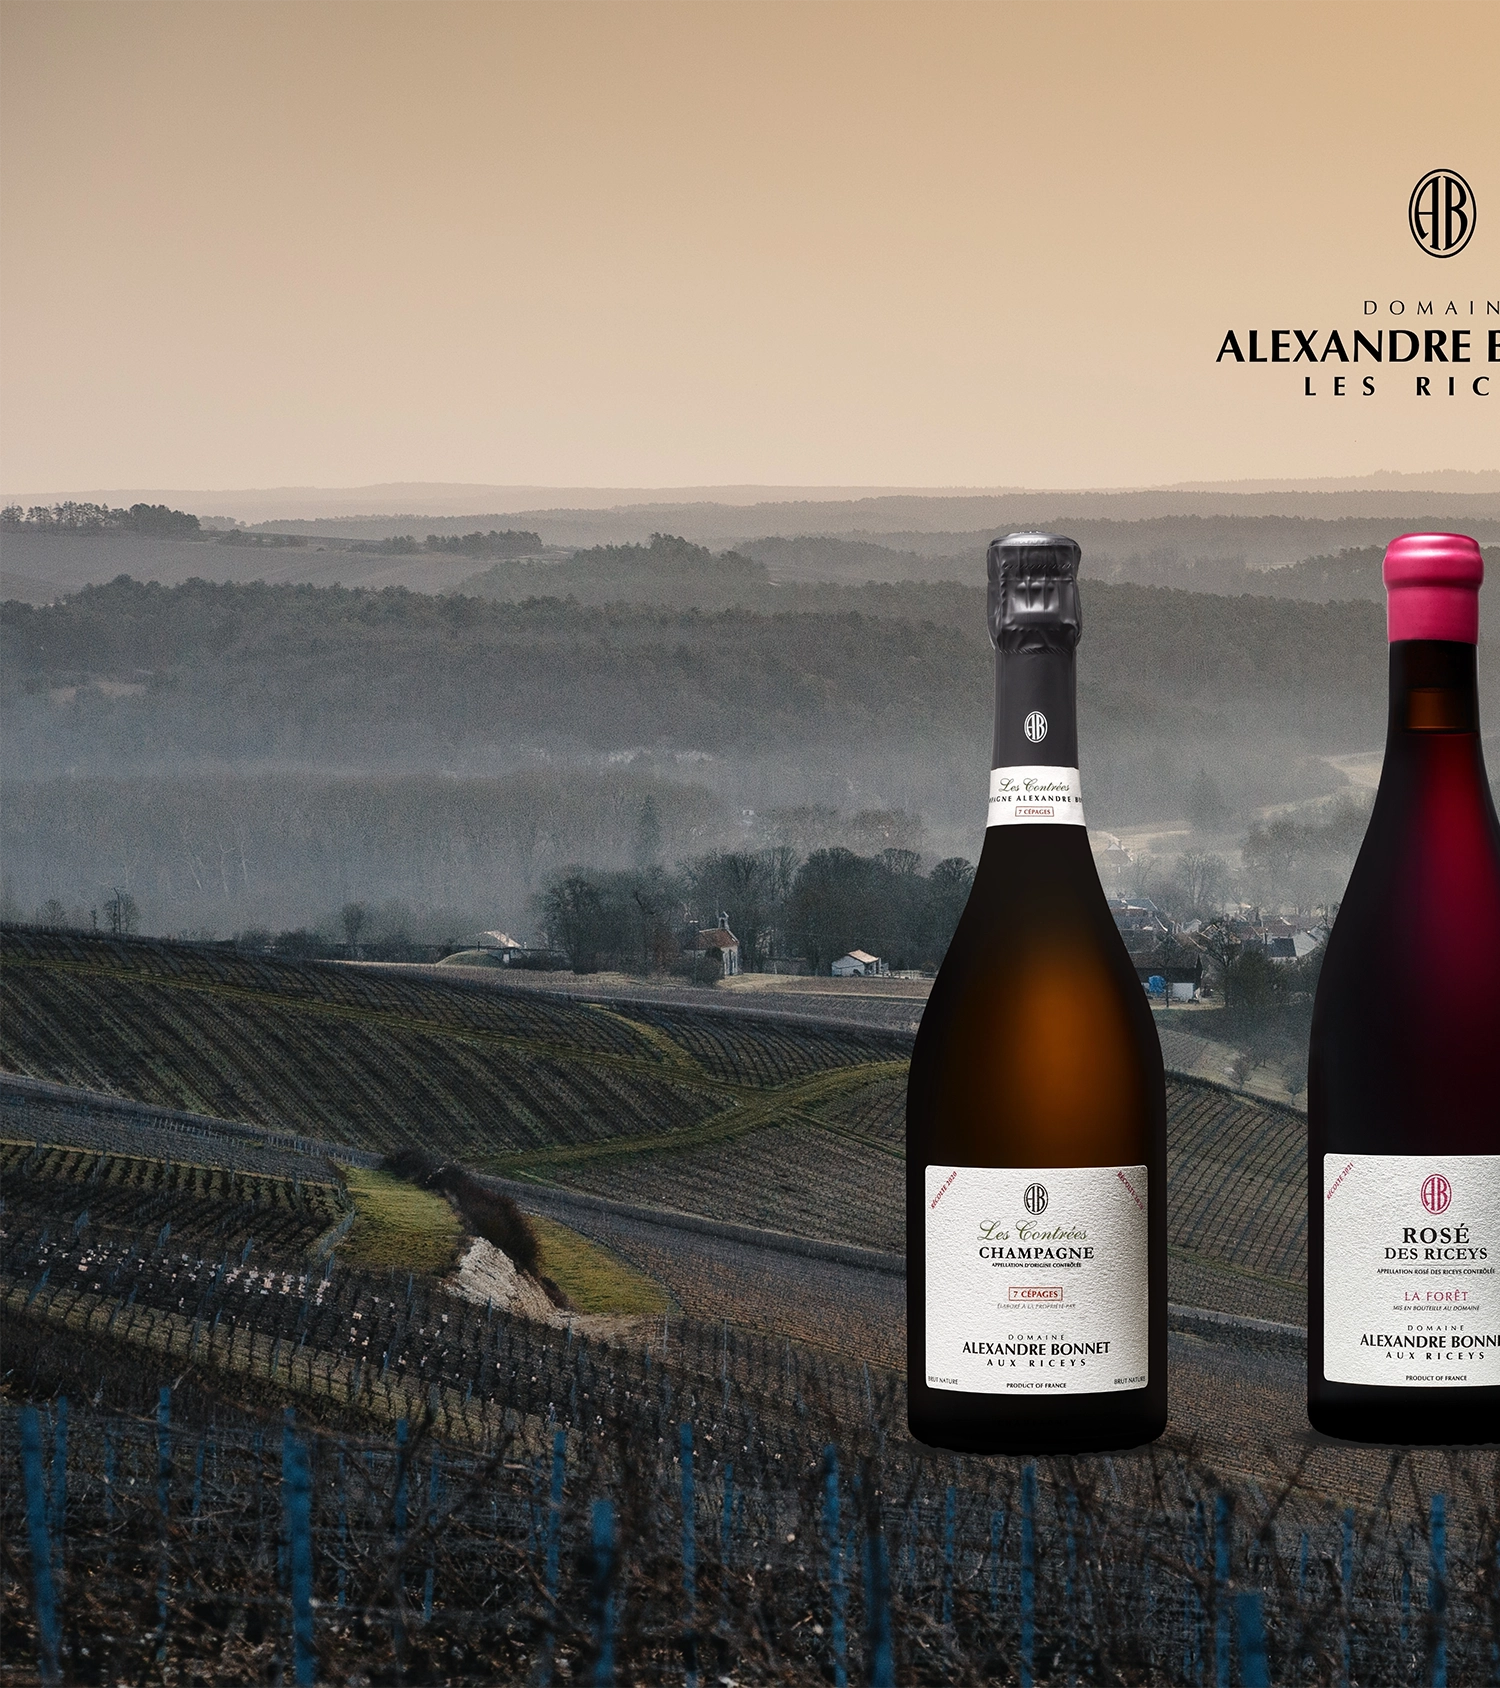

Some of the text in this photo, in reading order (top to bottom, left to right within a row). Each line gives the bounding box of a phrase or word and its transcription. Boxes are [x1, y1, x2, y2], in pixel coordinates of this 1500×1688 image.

[1026, 713, 1046, 741] AB
[998, 778, 1070, 792] Les Contrées
[1025, 1185, 1047, 1213] AB
[1423, 1176, 1450, 1212] AB
[977, 1220, 1088, 1241] Les Contrées
[1402, 1223, 1470, 1244] ROSÉ
[979, 1246, 1095, 1260] CHAMPAGNE
[1385, 1247, 1488, 1260] DES RICEYS
[1021, 1289, 1058, 1297] CÉPAGES
[1405, 1289, 1468, 1301] LA FORÊT
[1360, 1334, 1446, 1348] ALEXANDRE
[963, 1342, 1110, 1356] ALEXANDRE BONNET
[1386, 1351, 1484, 1360] AUX RICEYS
[987, 1359, 1086, 1367] AUX RICEYS
